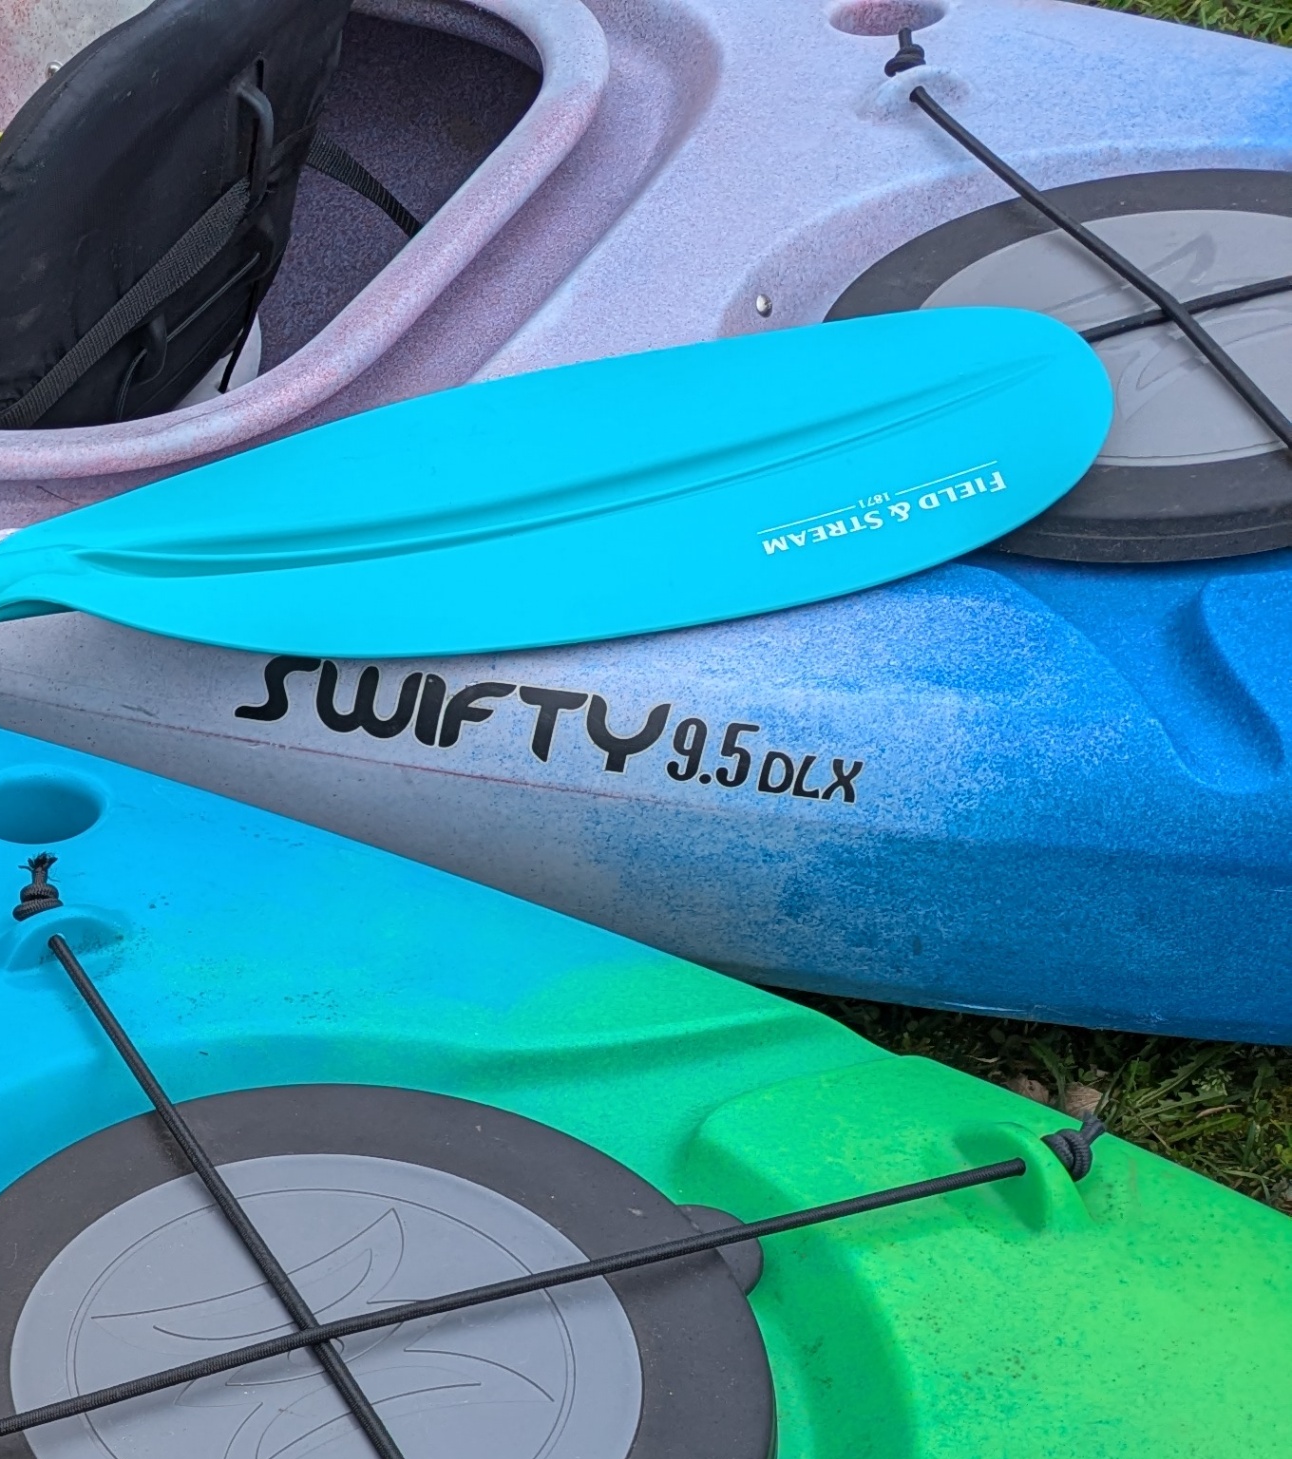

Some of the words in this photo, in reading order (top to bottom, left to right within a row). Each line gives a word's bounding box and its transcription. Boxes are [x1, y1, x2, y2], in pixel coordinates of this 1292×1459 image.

[857, 491, 891, 509] 1871
[918, 470, 1008, 510] FIELD
[886, 501, 912, 522] &
[761, 510, 884, 556] STREAM
[232, 653, 673, 775] SWIFTY
[664, 715, 762, 790] 9.5
[755, 749, 866, 805] DLX
